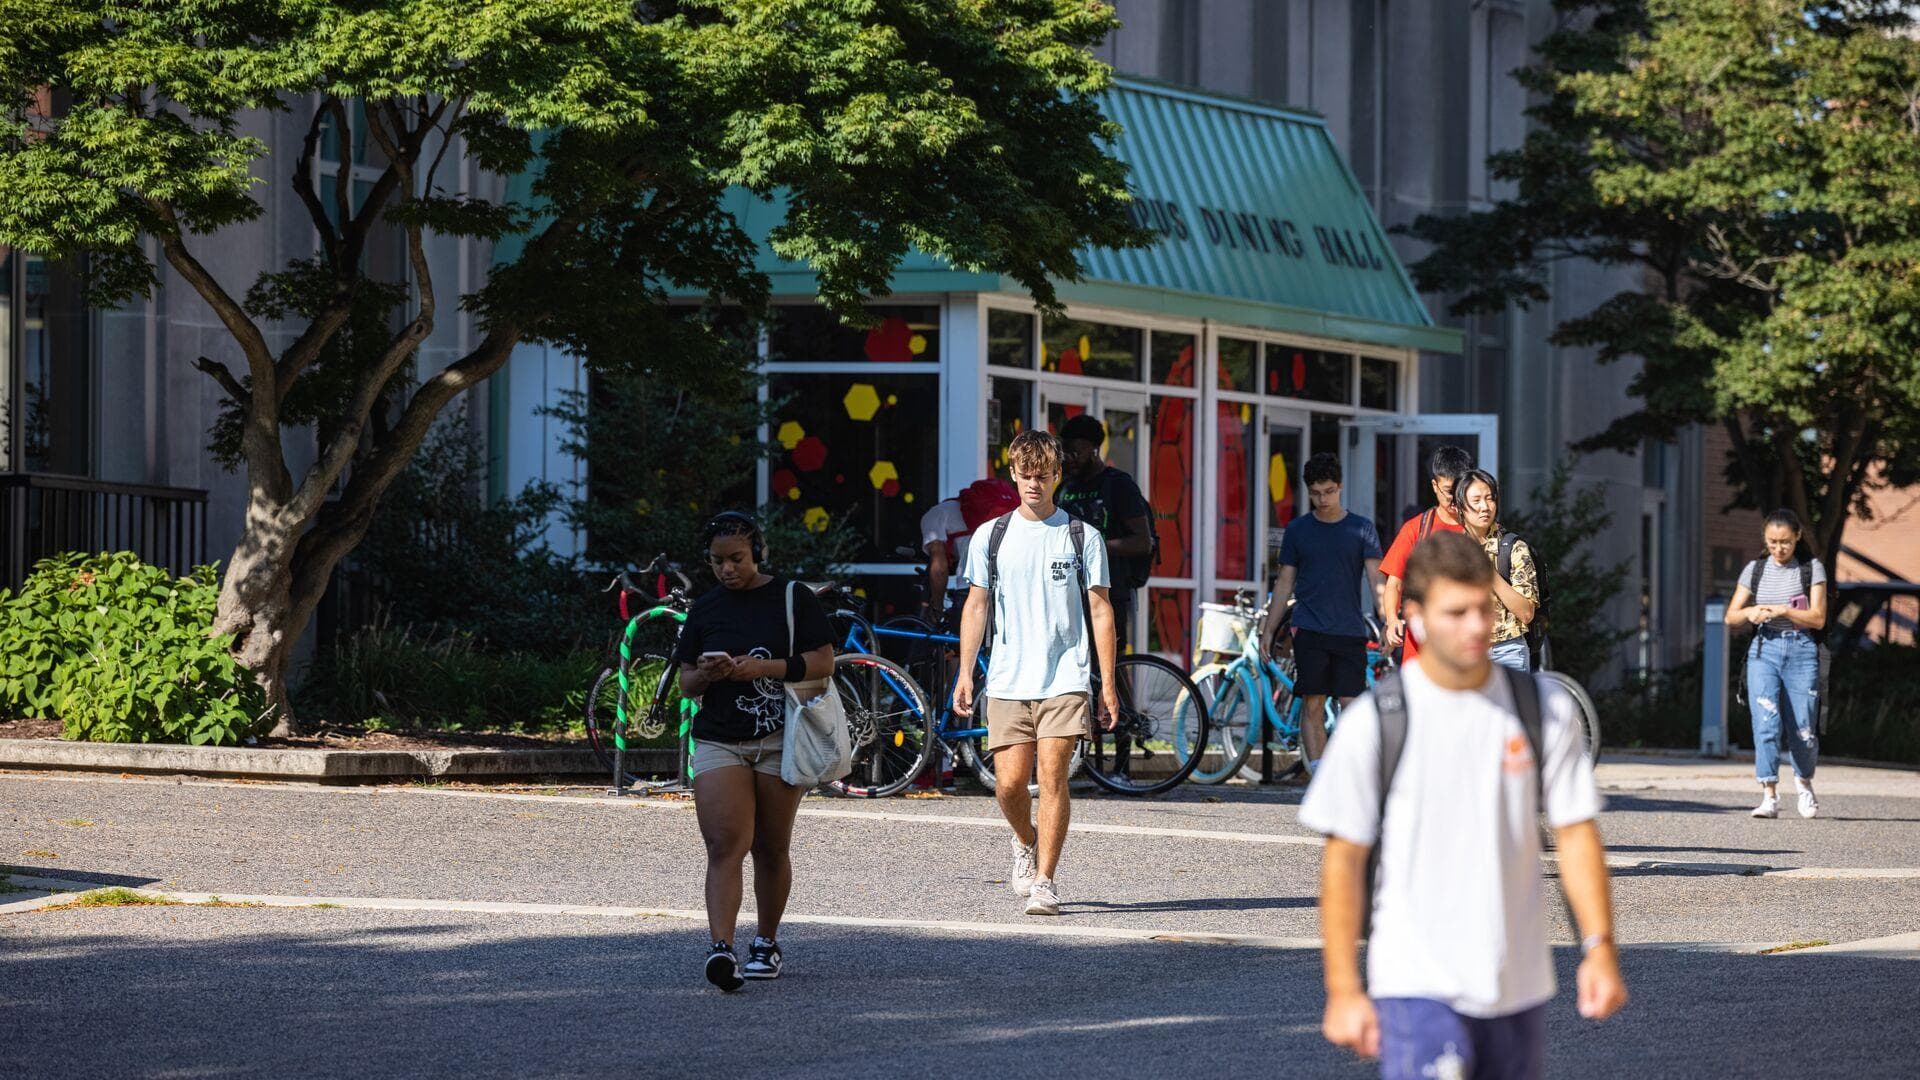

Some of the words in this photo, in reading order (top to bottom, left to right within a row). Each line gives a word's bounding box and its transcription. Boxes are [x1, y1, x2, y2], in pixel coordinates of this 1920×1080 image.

[1125, 197, 1188, 240] PUS
[1199, 205, 1304, 258] DINING
[1312, 224, 1383, 271] HALL
